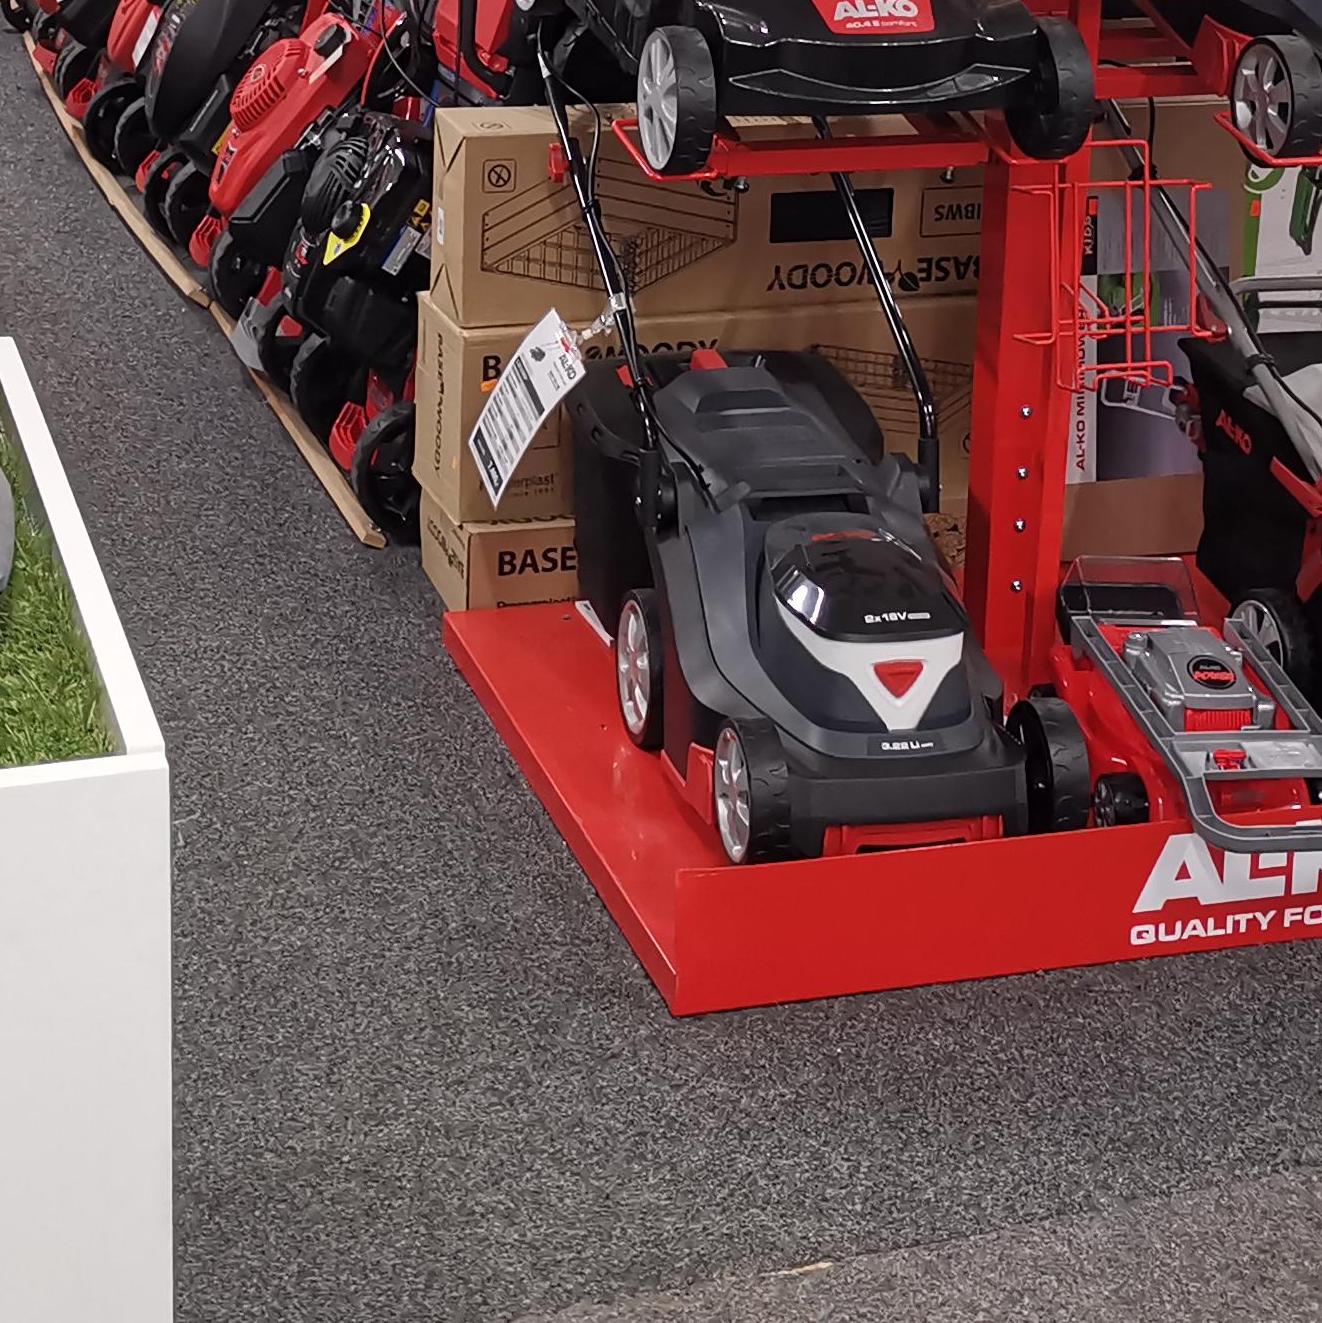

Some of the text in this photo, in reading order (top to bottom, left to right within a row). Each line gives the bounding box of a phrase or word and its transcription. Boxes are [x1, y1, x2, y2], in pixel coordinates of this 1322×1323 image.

[1075, 420, 1086, 472] AL-KO
[1215, 408, 1253, 454] AL-KO
[497, 546, 577, 576] BASE
[1130, 909, 1277, 946] QUALITY
